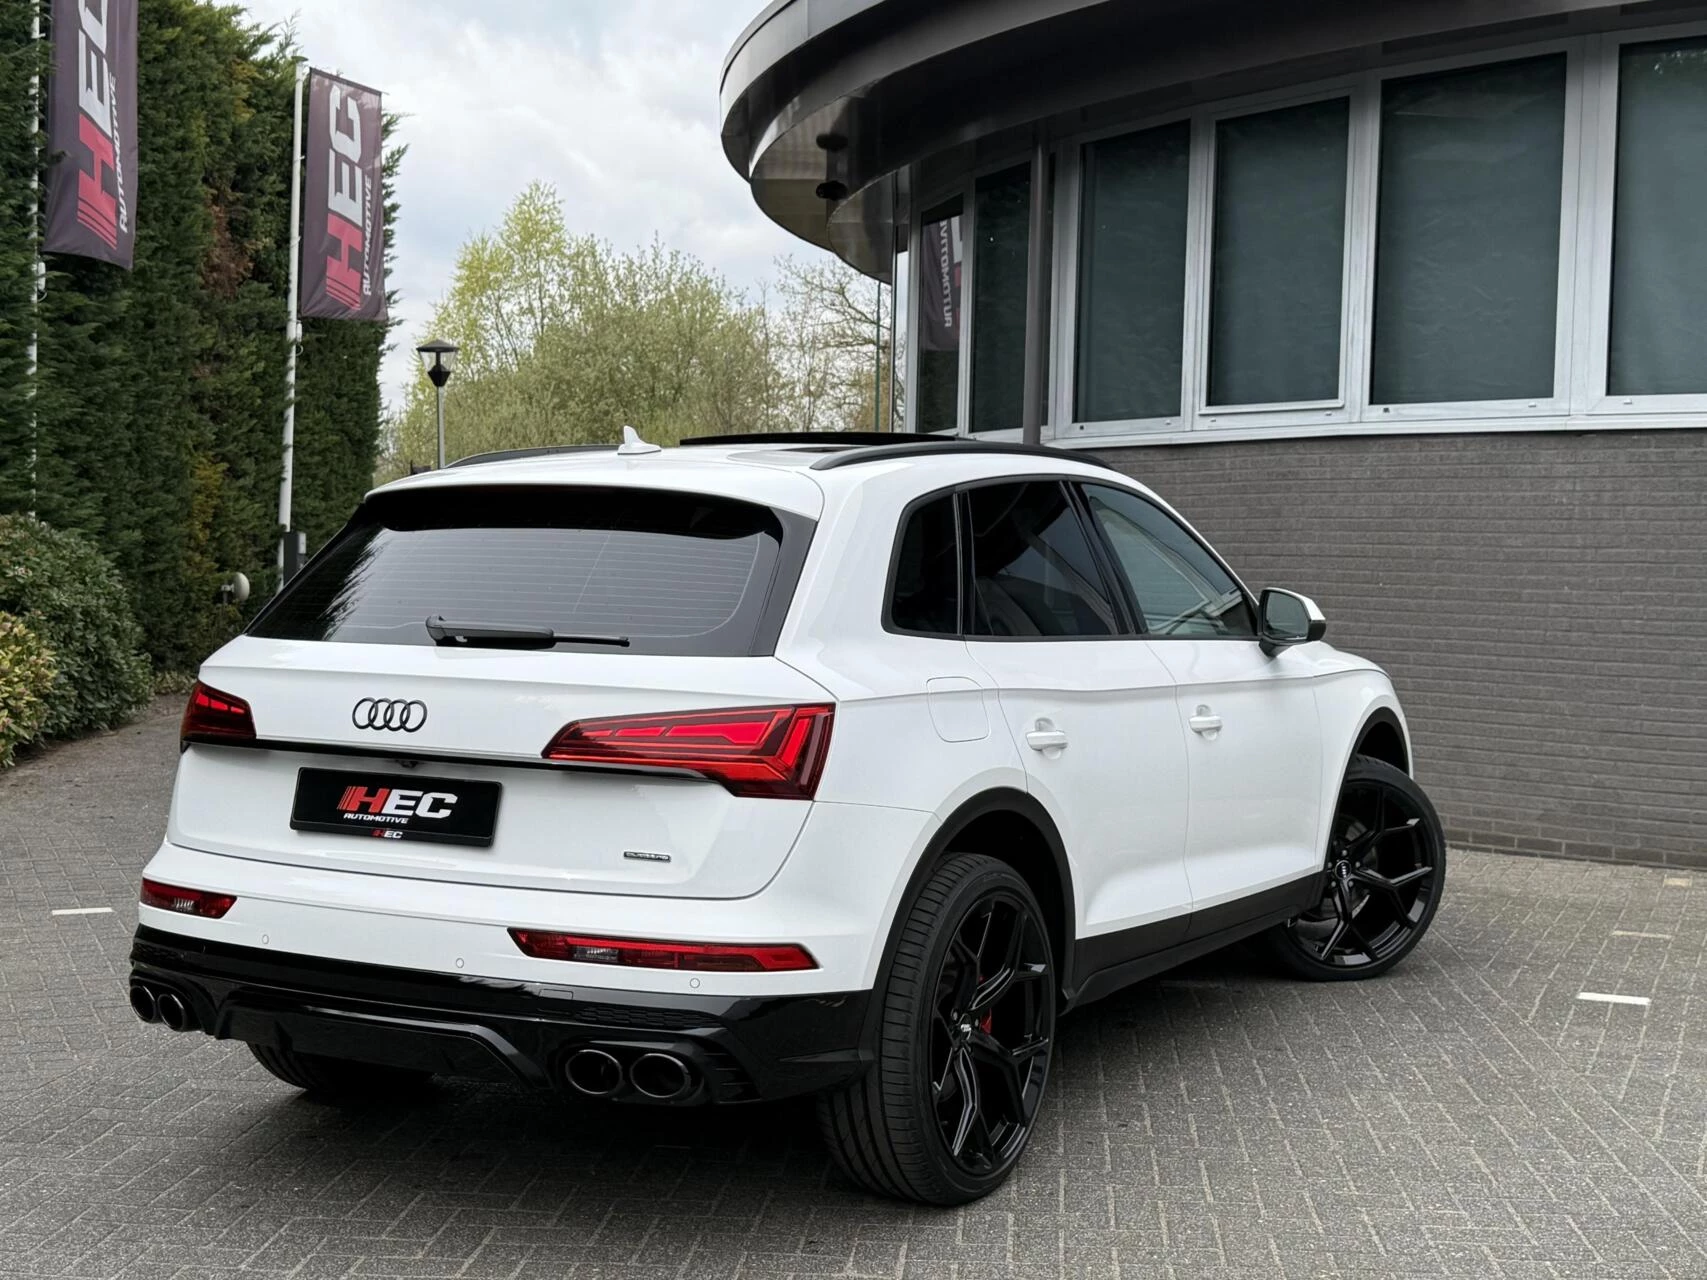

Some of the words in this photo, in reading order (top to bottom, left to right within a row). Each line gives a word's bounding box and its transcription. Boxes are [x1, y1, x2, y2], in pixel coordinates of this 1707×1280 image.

[109, 72, 128, 233] AUTOMOTIVE
[326, 84, 363, 310] HEC
[363, 174, 372, 296] AUTOMOTIVE
[337, 786, 458, 819] HEC
[343, 812, 409, 824] AUTOMOTIVE
[371, 828, 403, 839] HEC
